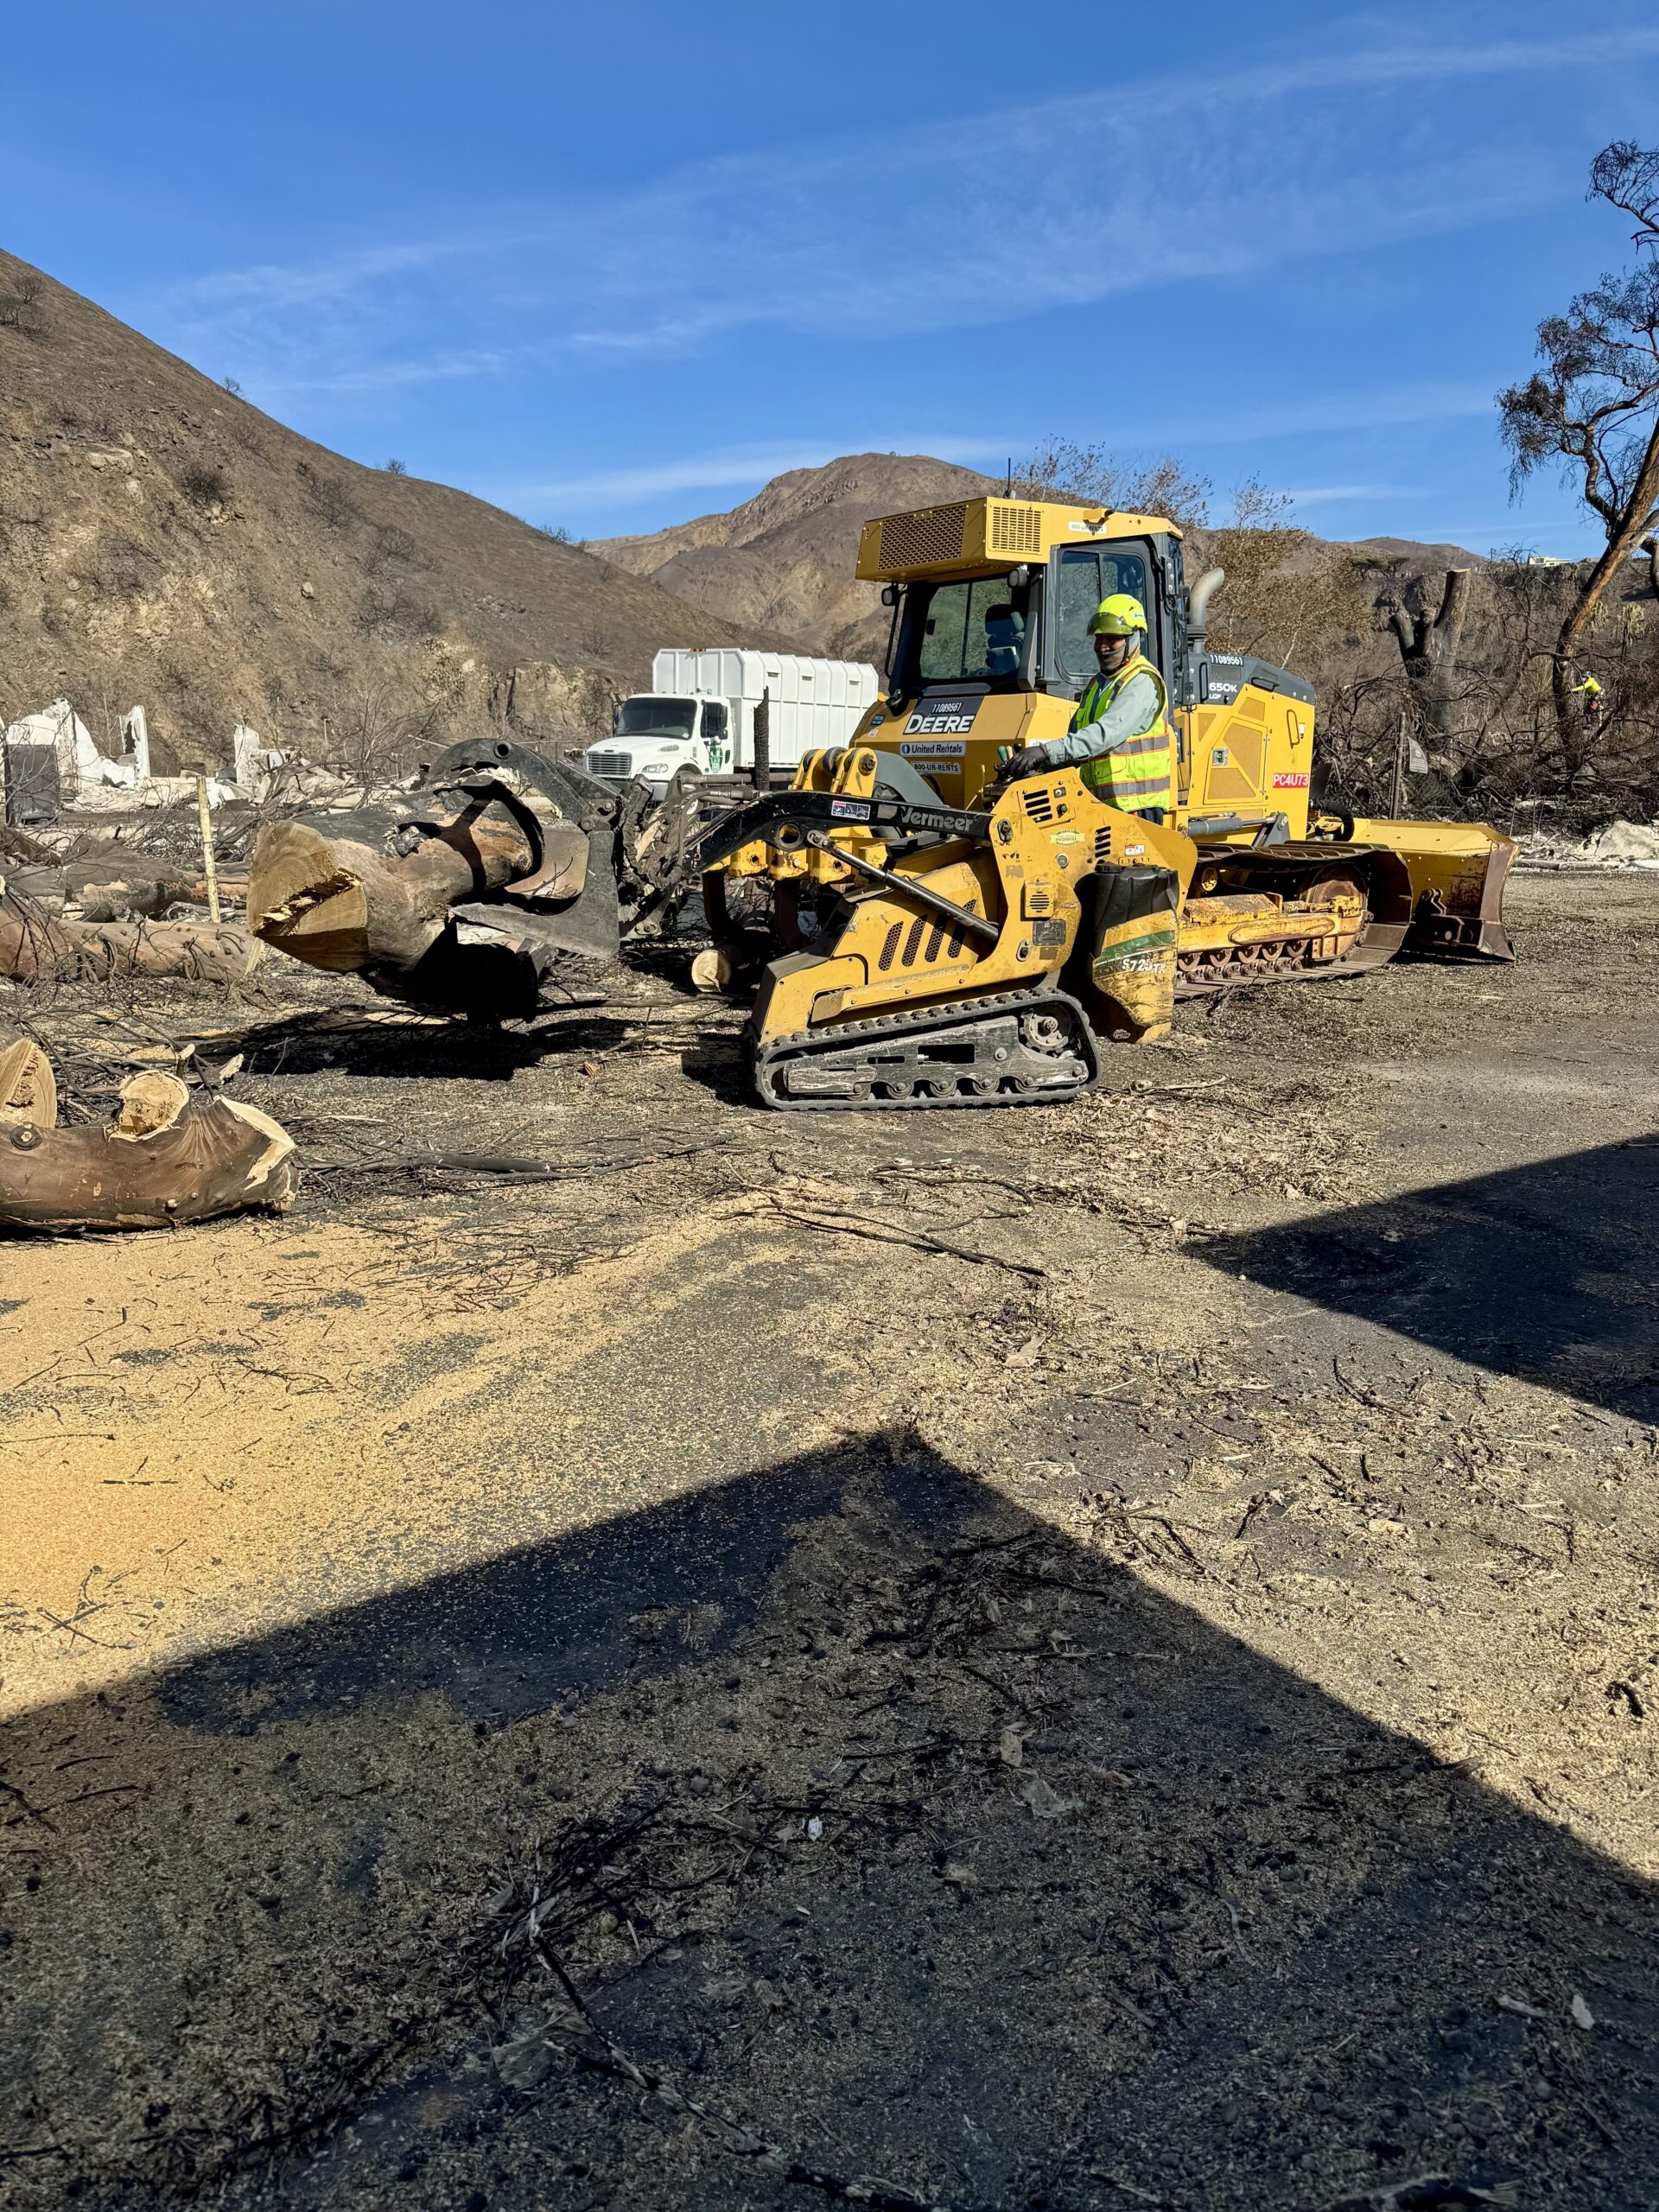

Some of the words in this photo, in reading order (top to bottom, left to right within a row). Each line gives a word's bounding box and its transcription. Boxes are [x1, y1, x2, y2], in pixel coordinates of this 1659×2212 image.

[1210, 655, 1243, 665] 11089561
[1209, 683, 1237, 692] 650K
[932, 702, 962, 713] 11089561
[904, 715, 975, 734] DEERE
[912, 745, 934, 753] United
[936, 743, 963, 753] Rentals
[913, 763, 958, 772] 800-UR-RENTS
[1273, 774, 1308, 786] PC4U73
[900, 806, 974, 832] Vermeer
